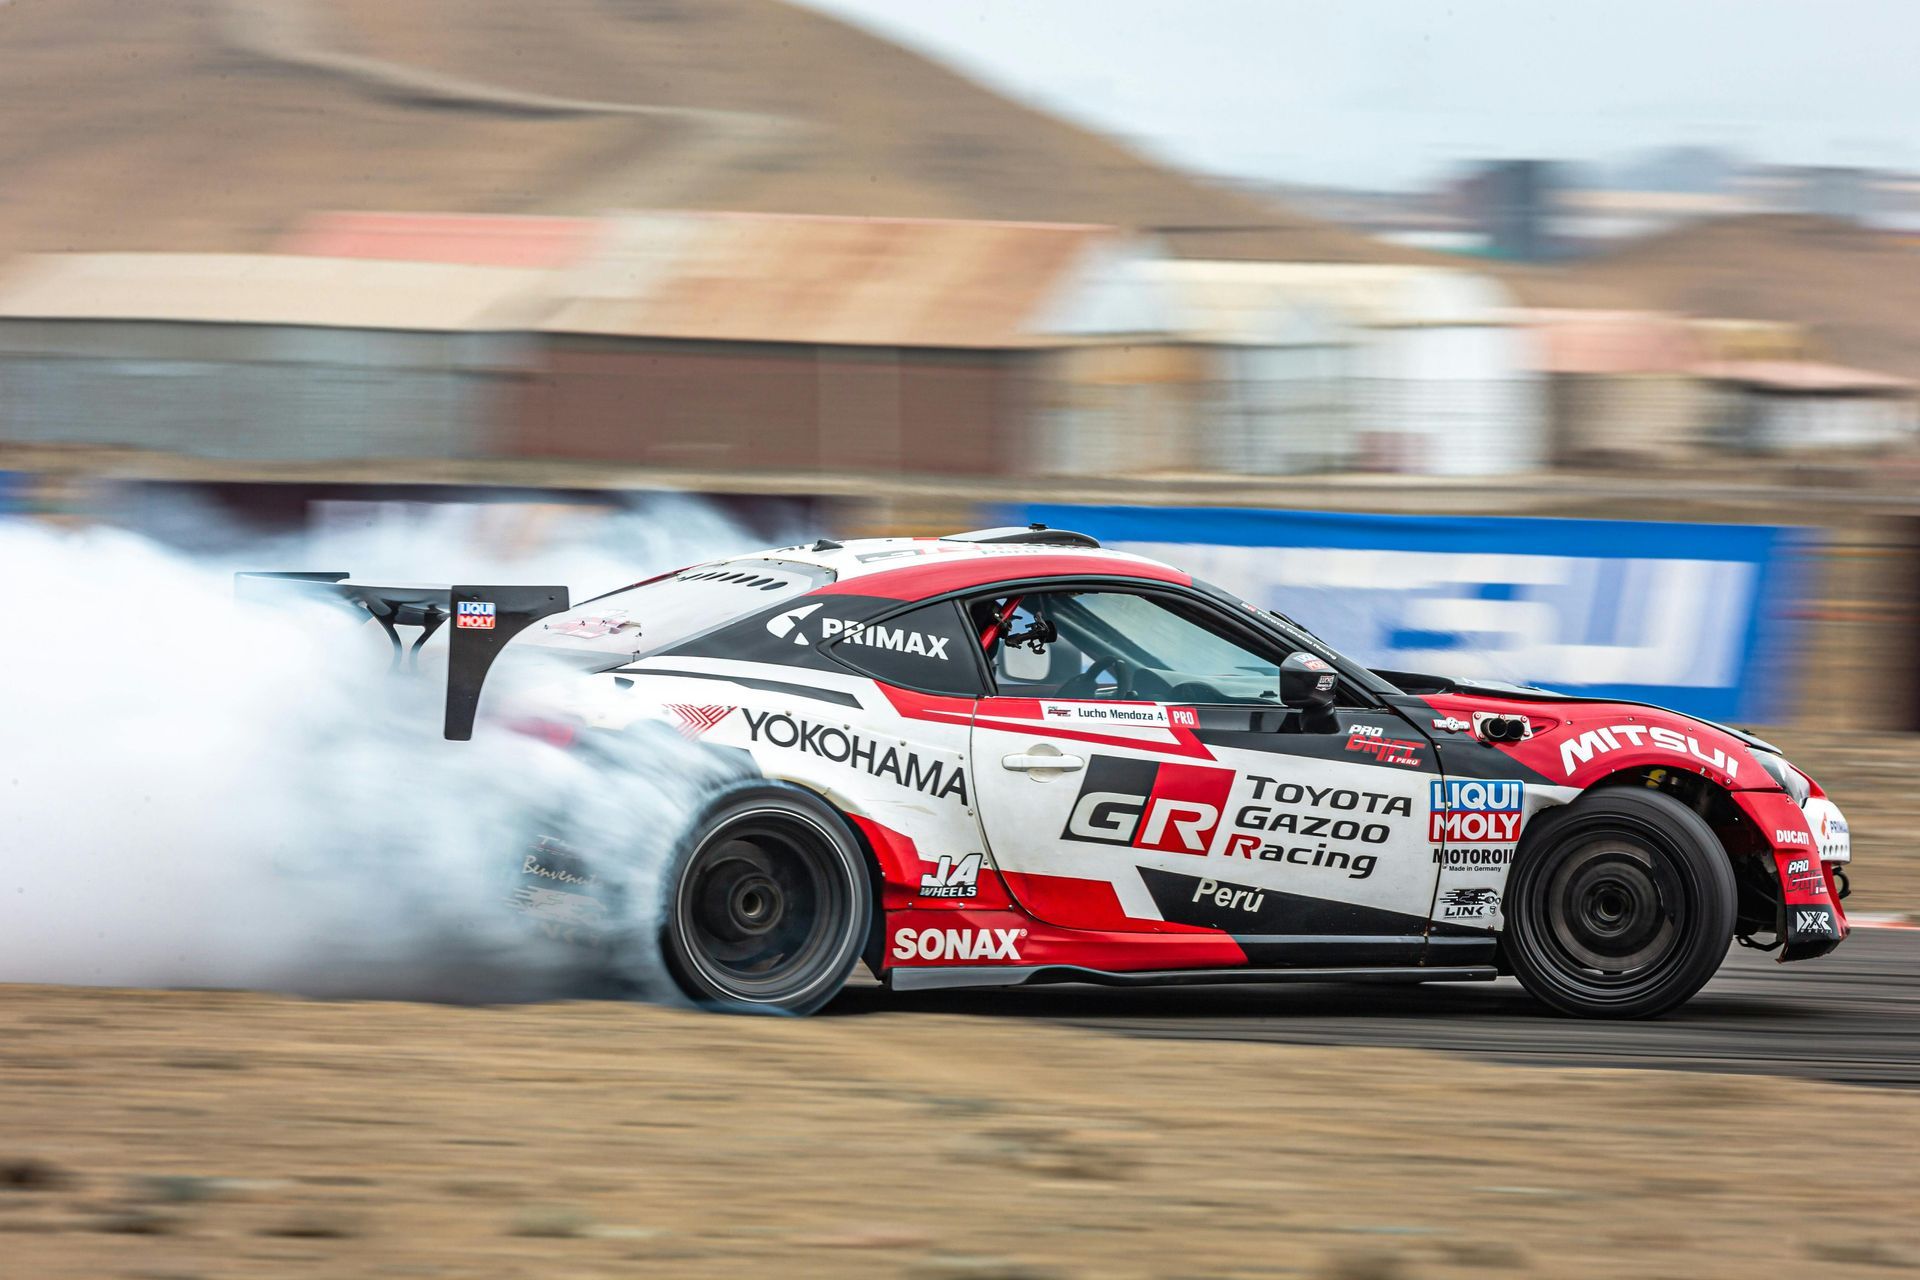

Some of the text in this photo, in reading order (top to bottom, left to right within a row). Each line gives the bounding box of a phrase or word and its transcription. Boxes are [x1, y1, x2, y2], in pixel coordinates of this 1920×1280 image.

[461, 603, 495, 615] LIQUI
[461, 616, 494, 627] MOLY
[822, 617, 950, 661] PRIMAX
[1078, 707, 1107, 718] Lucho
[1110, 709, 1154, 721] Mendoza
[1172, 710, 1194, 725] PRO
[1348, 724, 1384, 737] PRO
[741, 707, 969, 806] YOKOHAMA
[1345, 734, 1426, 762] DRIFT
[1559, 725, 1739, 777] MITSUI
[1246, 774, 1412, 818] TOYOTA
[1434, 782, 1519, 811] LIQUI
[1068, 791, 1220, 851] GR
[1234, 806, 1391, 844] GAZOO
[1433, 813, 1521, 840] MOLY
[1776, 829, 1810, 846] DUCATI
[920, 853, 983, 887] JA
[1223, 833, 1378, 880] Racing
[1474, 865, 1502, 873] Germany
[1788, 859, 1809, 875] PRO
[920, 886, 977, 897] WHEELS
[1191, 877, 1265, 914] Perú
[1445, 906, 1485, 916] LINK
